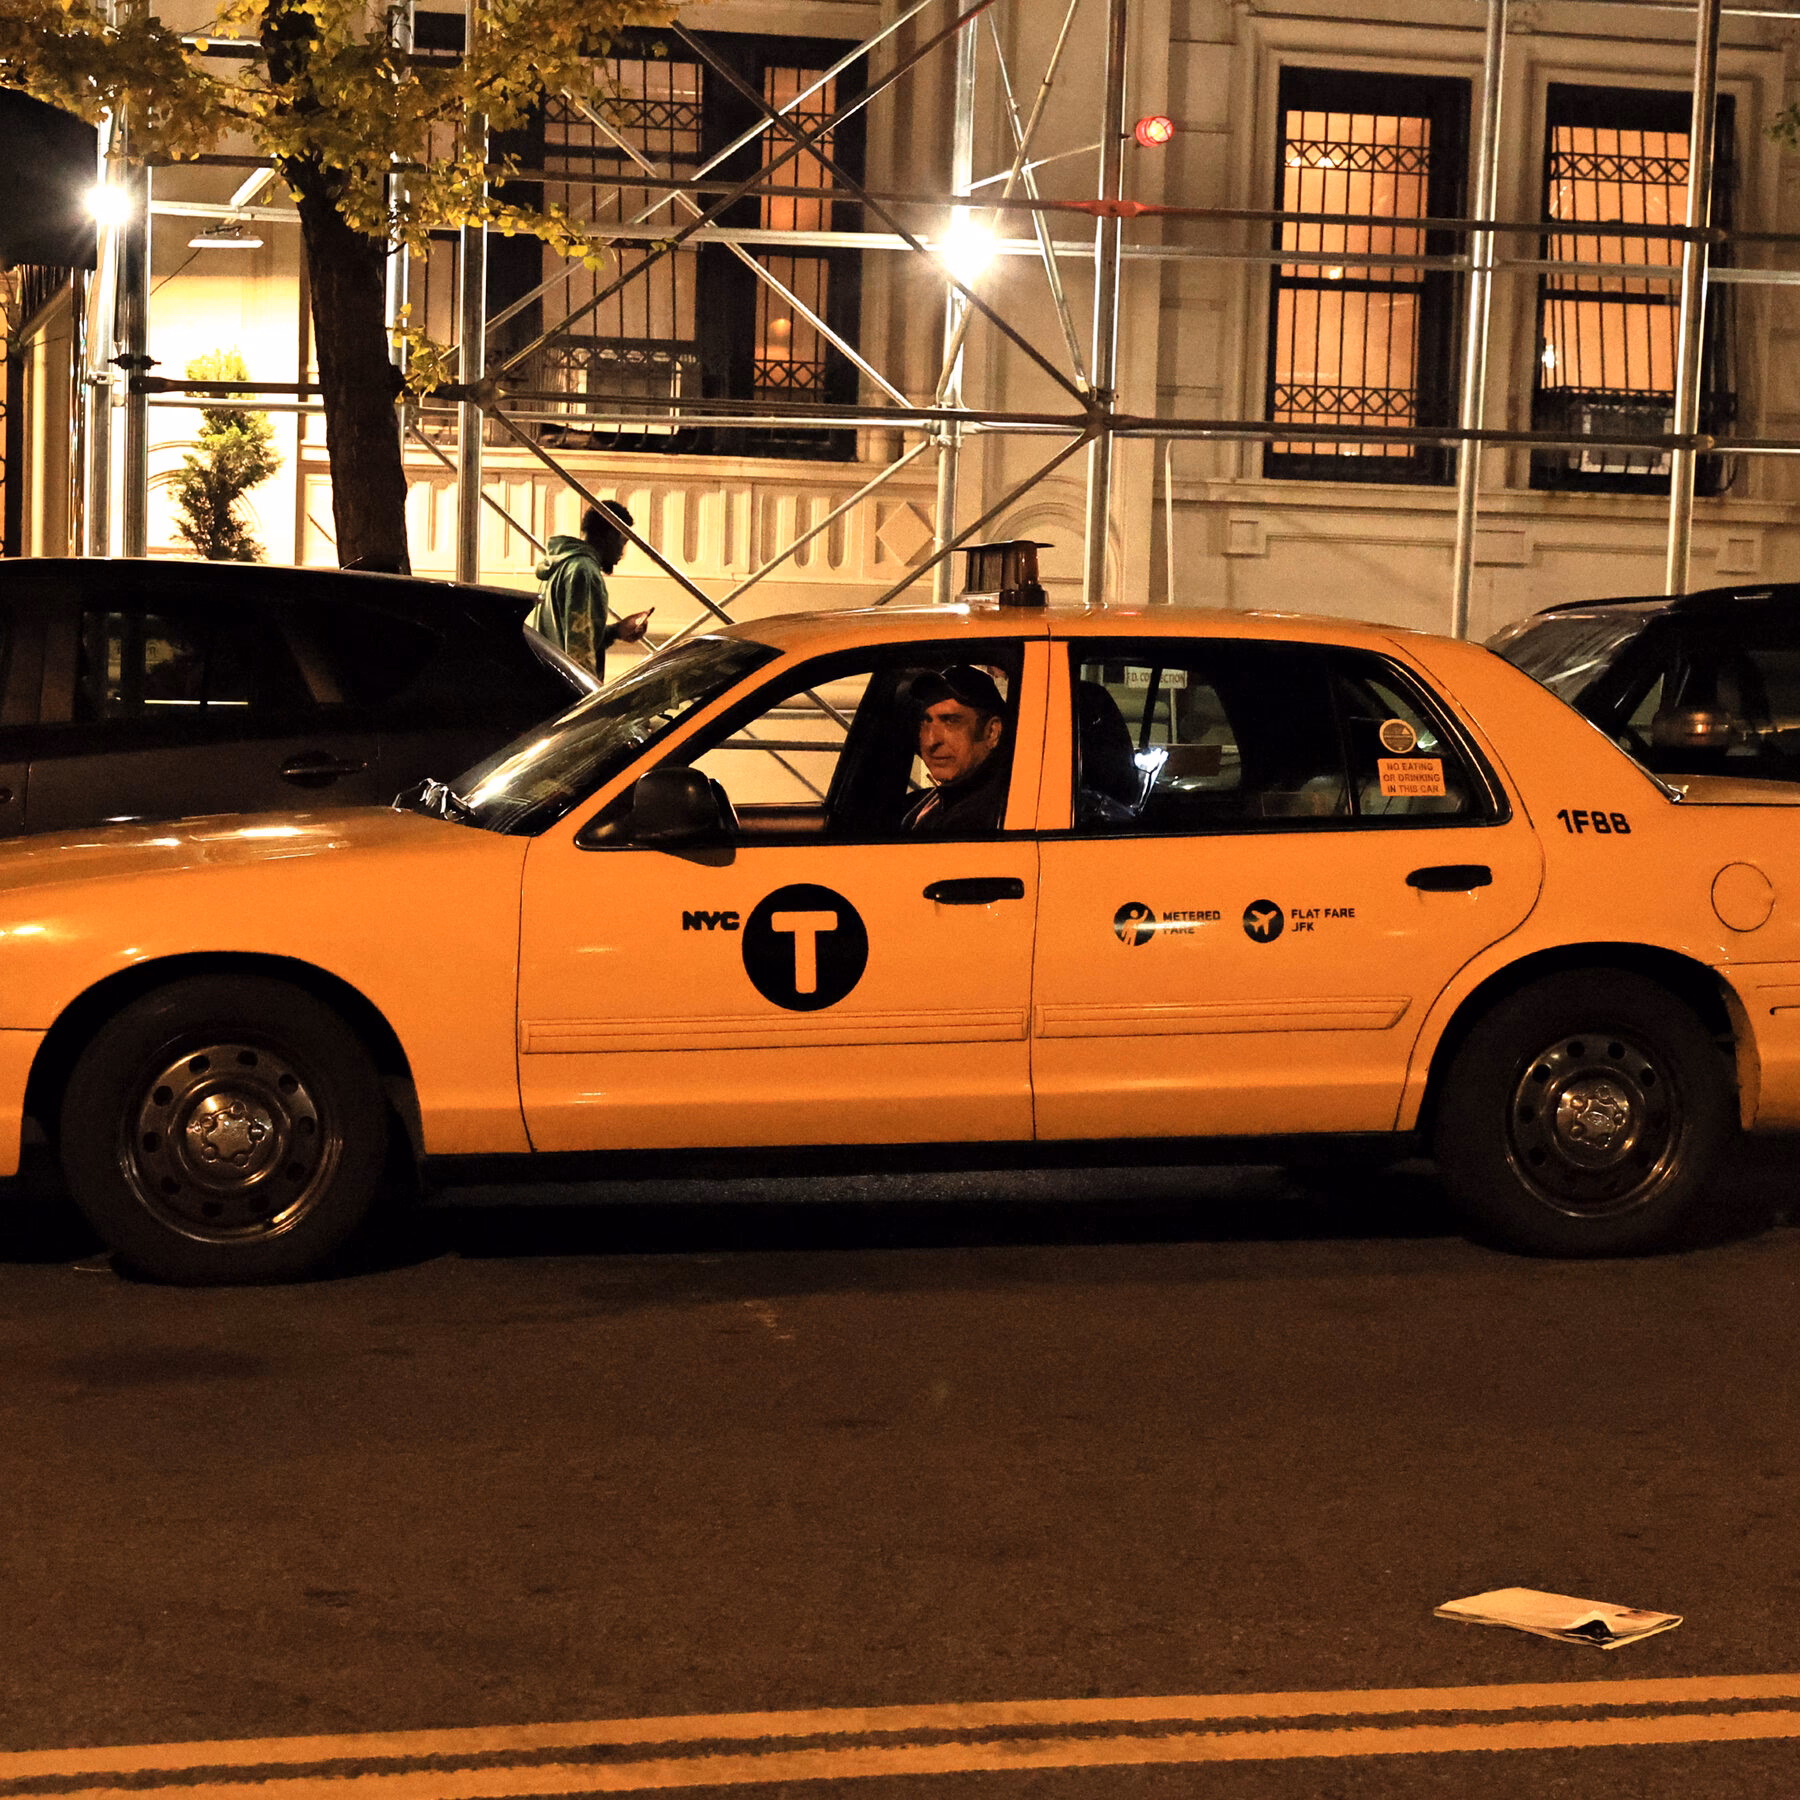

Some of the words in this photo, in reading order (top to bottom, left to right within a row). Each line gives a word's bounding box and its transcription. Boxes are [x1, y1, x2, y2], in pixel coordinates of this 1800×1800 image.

[1386, 762, 1399, 770] NO
[1401, 762, 1434, 770] EATING
[1383, 774, 1396, 782] OR
[1398, 773, 1440, 782] DRINKING
[1387, 785, 1397, 793] IN
[1163, 910, 1220, 920] METERED
[1291, 909, 1320, 919] FLAT
[1324, 908, 1355, 918] FARE
[1291, 922, 1315, 932] JFK
[682, 911, 740, 931] NYC
[771, 911, 838, 994] T
